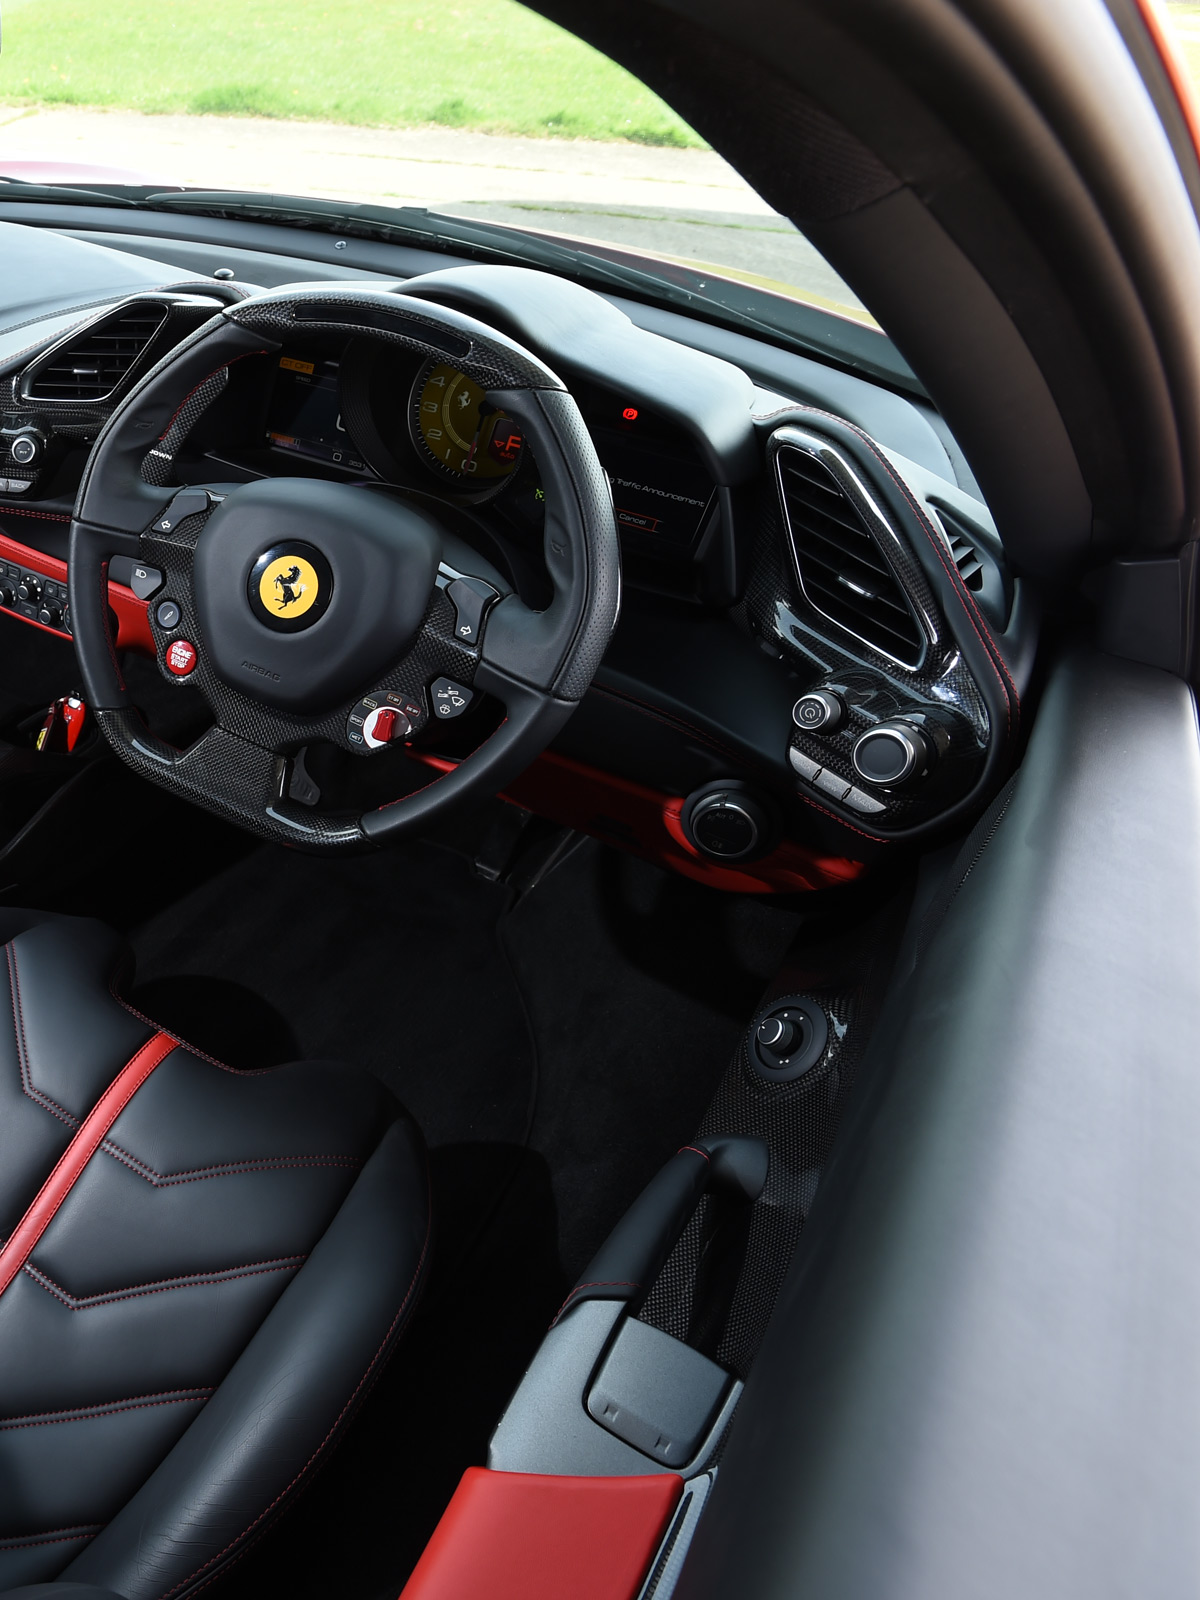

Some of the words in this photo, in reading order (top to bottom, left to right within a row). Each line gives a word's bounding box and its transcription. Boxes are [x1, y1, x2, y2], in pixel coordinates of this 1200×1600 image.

[294, 361, 313, 371] OFF
[429, 376, 445, 387] 4
[422, 401, 438, 413] 3
[426, 428, 442, 440] 2
[505, 435, 521, 451] F
[445, 448, 451, 460] 1
[461, 459, 477, 472] 0
[616, 477, 642, 490] Traffic
[641, 485, 705, 507] Announcement
[619, 513, 647, 525] Cancel
[241, 660, 281, 682] AIRBAG
[351, 716, 362, 724] SPORT
[852, 794, 873, 810] MAIN
